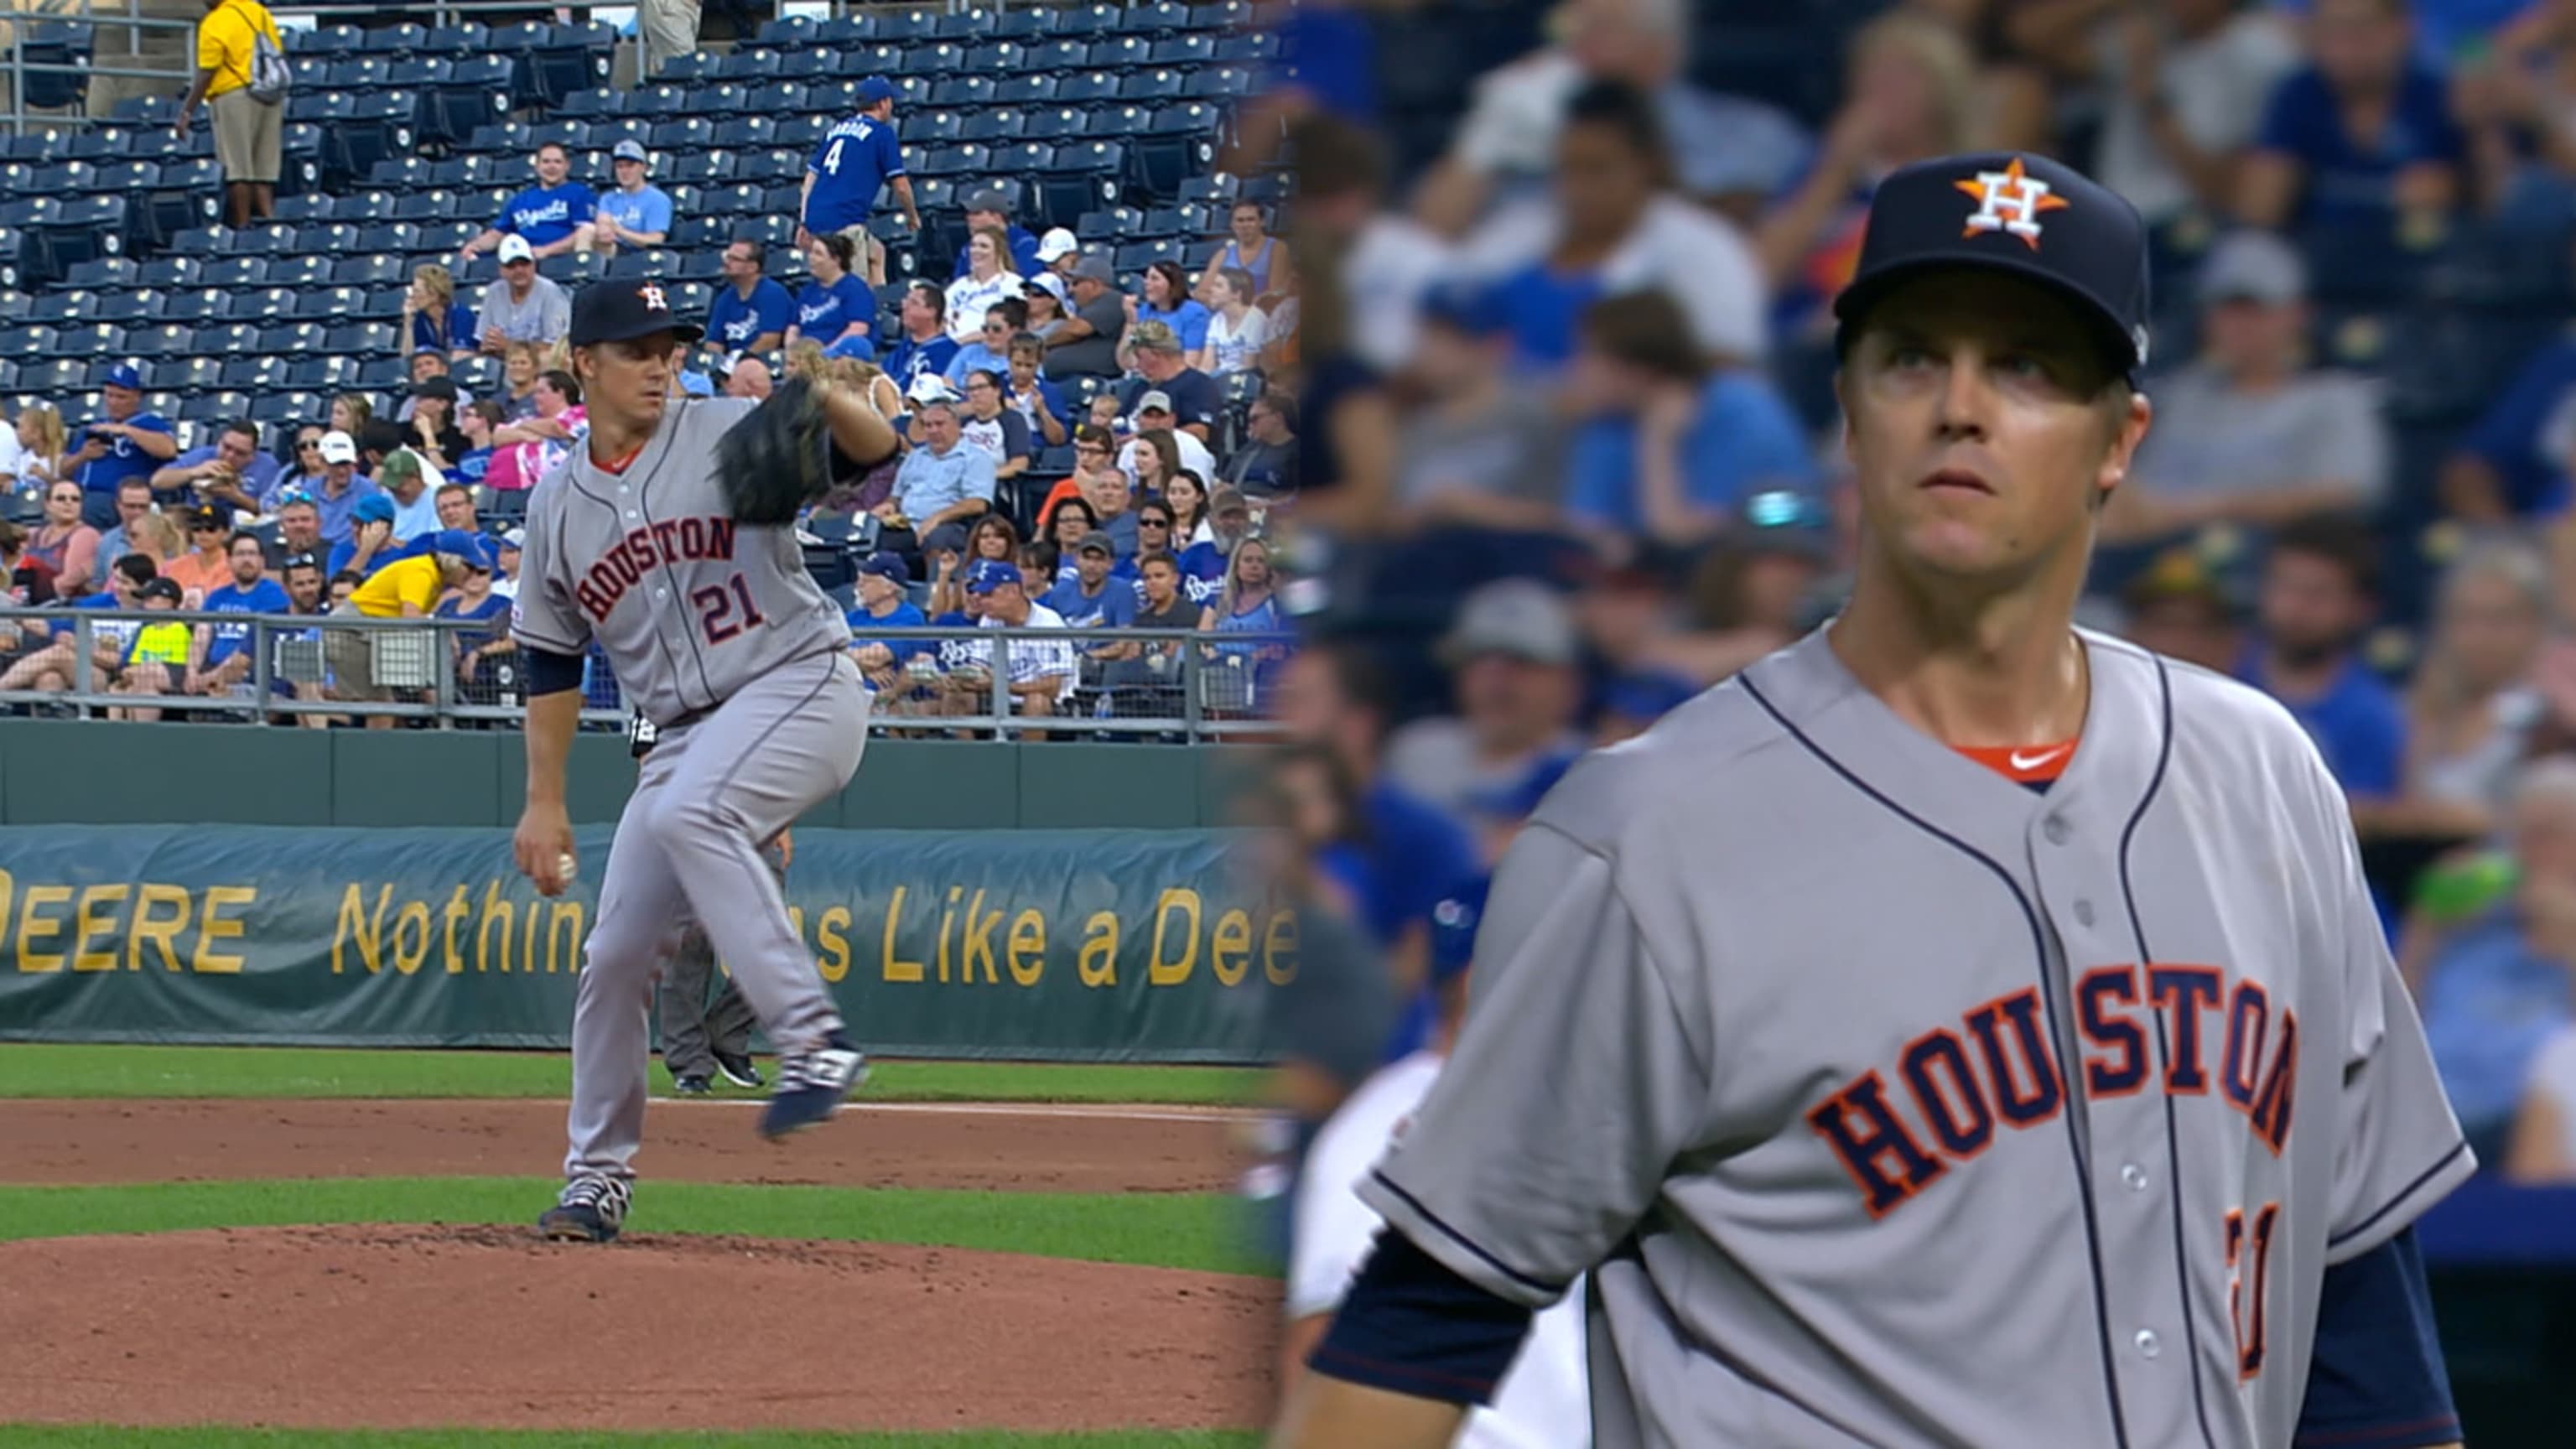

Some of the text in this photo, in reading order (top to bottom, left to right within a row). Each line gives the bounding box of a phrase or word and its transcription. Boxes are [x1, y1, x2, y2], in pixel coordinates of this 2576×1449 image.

[823, 138, 844, 175] 4
[1964, 168, 2051, 238] H
[578, 516, 736, 624] HOUSTON
[692, 572, 764, 645] 21
[0, 867, 257, 973] EERE
[330, 879, 583, 975] Nothin
[883, 886, 1046, 986] Like
[1078, 910, 1119, 988] a
[1805, 963, 2298, 1220] HOUSTON
